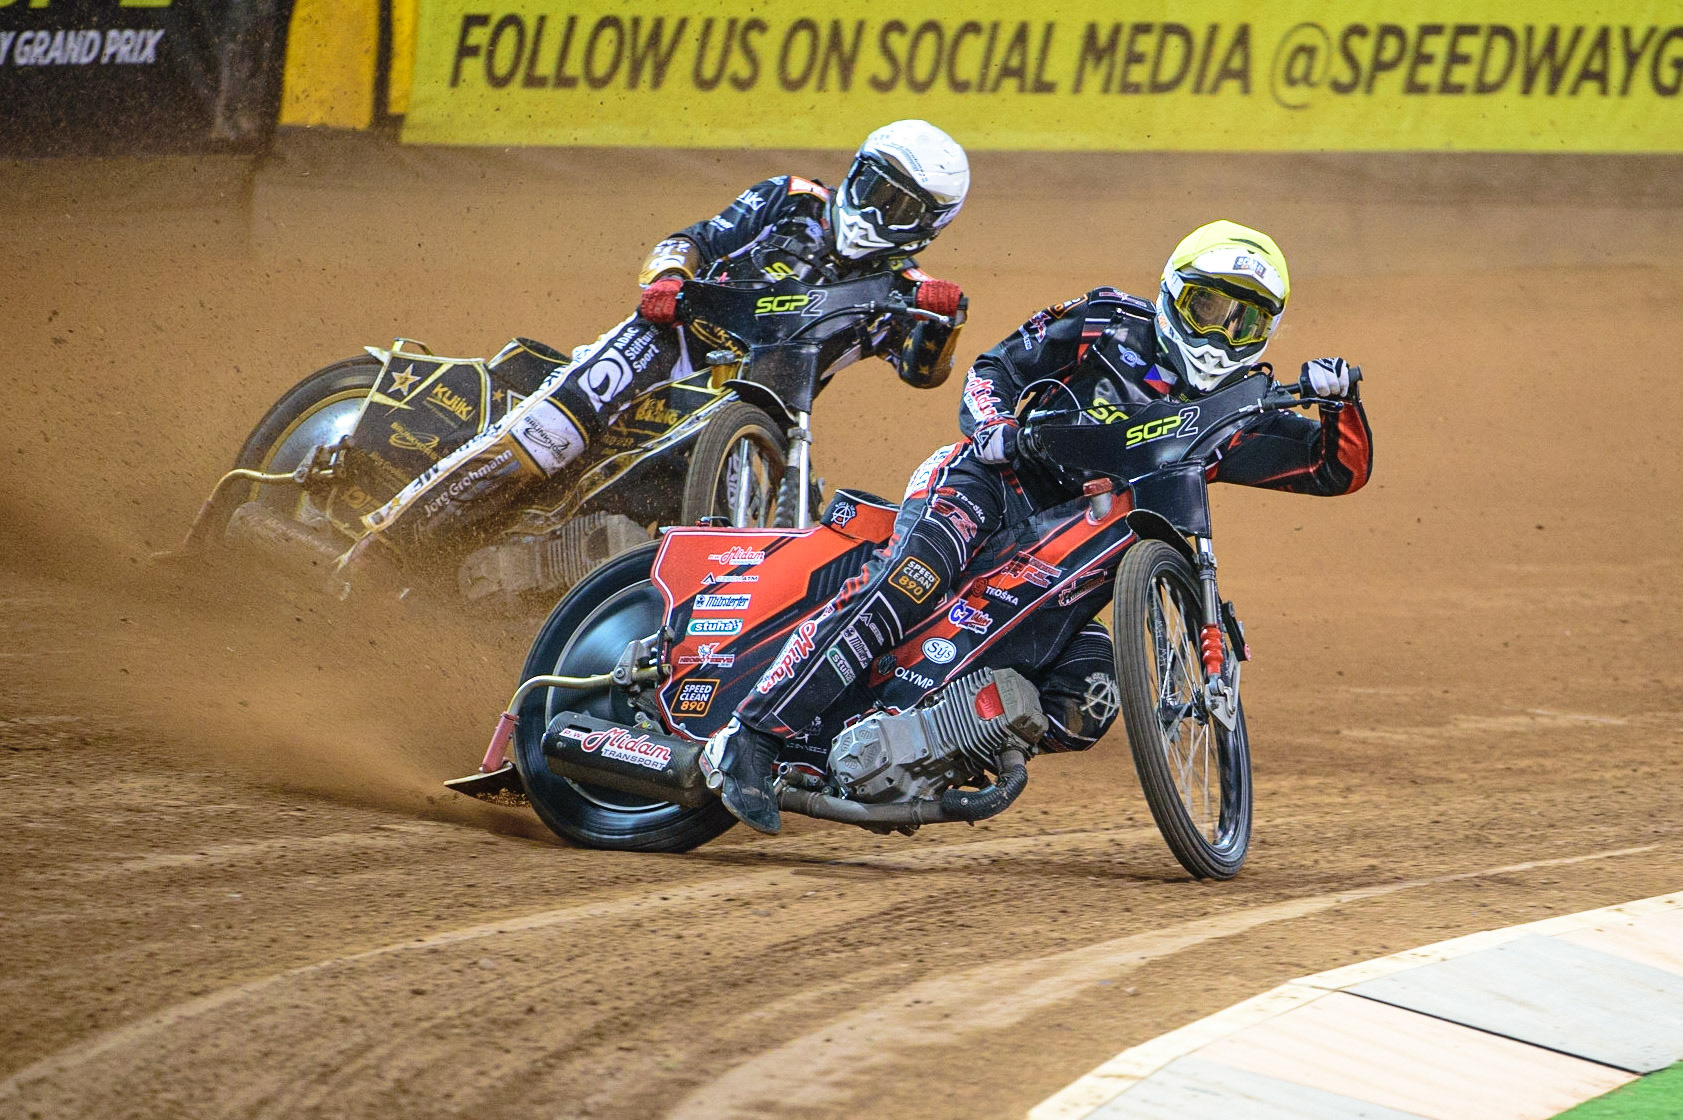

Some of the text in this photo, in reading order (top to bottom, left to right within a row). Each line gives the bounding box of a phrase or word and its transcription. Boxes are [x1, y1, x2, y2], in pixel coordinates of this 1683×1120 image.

[14, 29, 101, 66] GRAND
[101, 28, 166, 65] PRIX
[449, 14, 690, 91] FOLLOW
[692, 17, 768, 92] US
[777, 18, 866, 93] ON
[866, 20, 1058, 95] SOCIAL
[1071, 22, 1253, 96] MEDIA
[755, 289, 828, 317] SGP2
[613, 326, 640, 350] ADAC
[632, 342, 660, 373] Sport
[1125, 406, 1200, 447] SGP2
[448, 449, 514, 496] Grohmann
[720, 546, 765, 564] Midam
[903, 566, 932, 590] CLEAN
[908, 560, 935, 583] SPEED
[898, 575, 924, 596] 890
[682, 684, 713, 694] SPEED
[894, 666, 934, 689] OLYMP
[680, 692, 710, 702] CLEAN
[680, 701, 706, 712] 890
[582, 728, 671, 761] Midam
[603, 748, 666, 770] TRANSPORT
